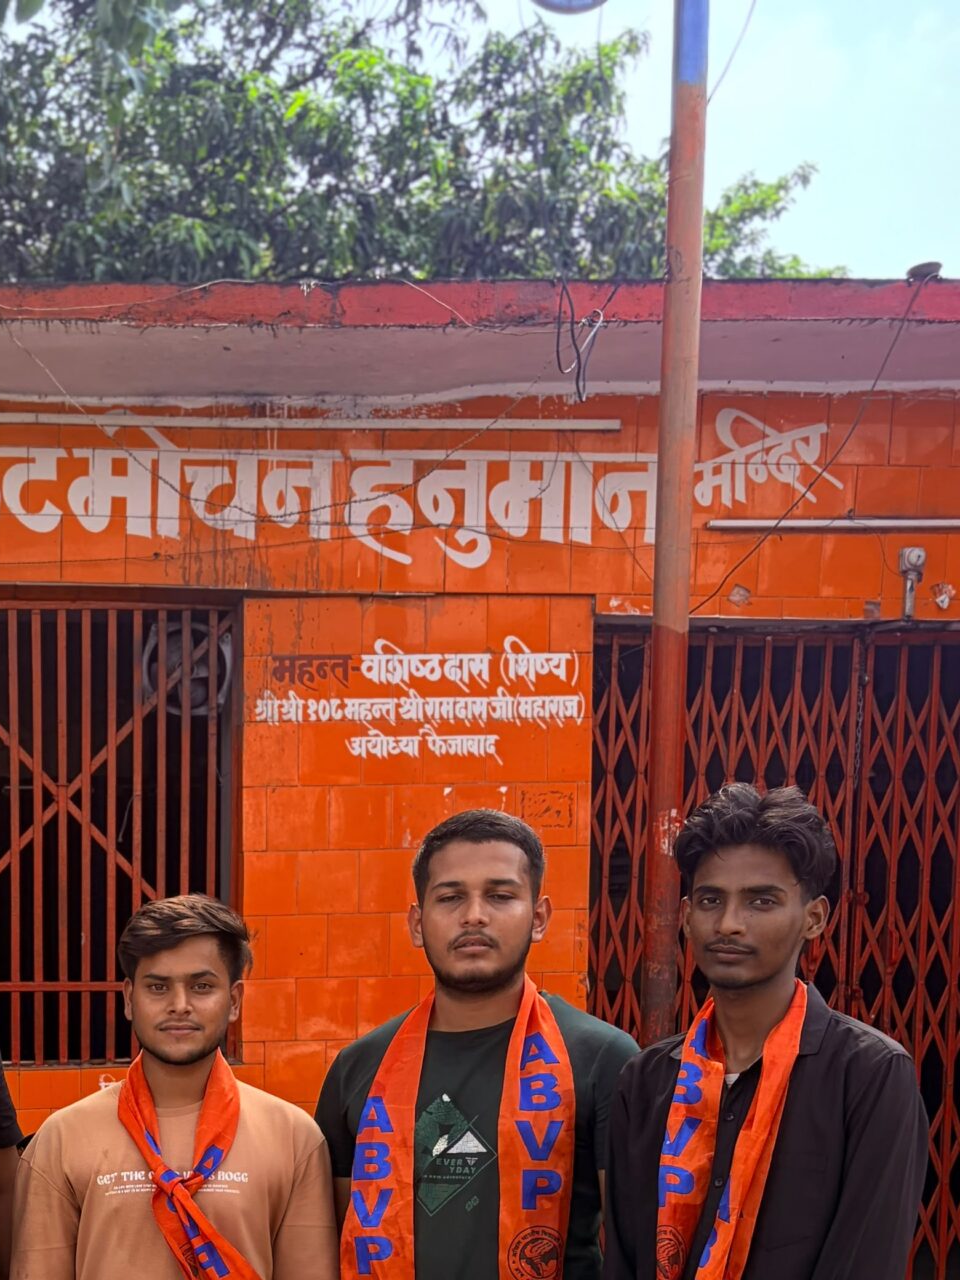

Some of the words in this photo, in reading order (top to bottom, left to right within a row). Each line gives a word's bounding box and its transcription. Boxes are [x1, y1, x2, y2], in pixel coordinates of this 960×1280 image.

[348, 449, 658, 568] हनुमान
[96, 1171, 119, 1186] GET
[121, 1170, 145, 1182] THE
[352, 1096, 394, 1275] ABVP
[515, 1031, 564, 1211] ABVP
